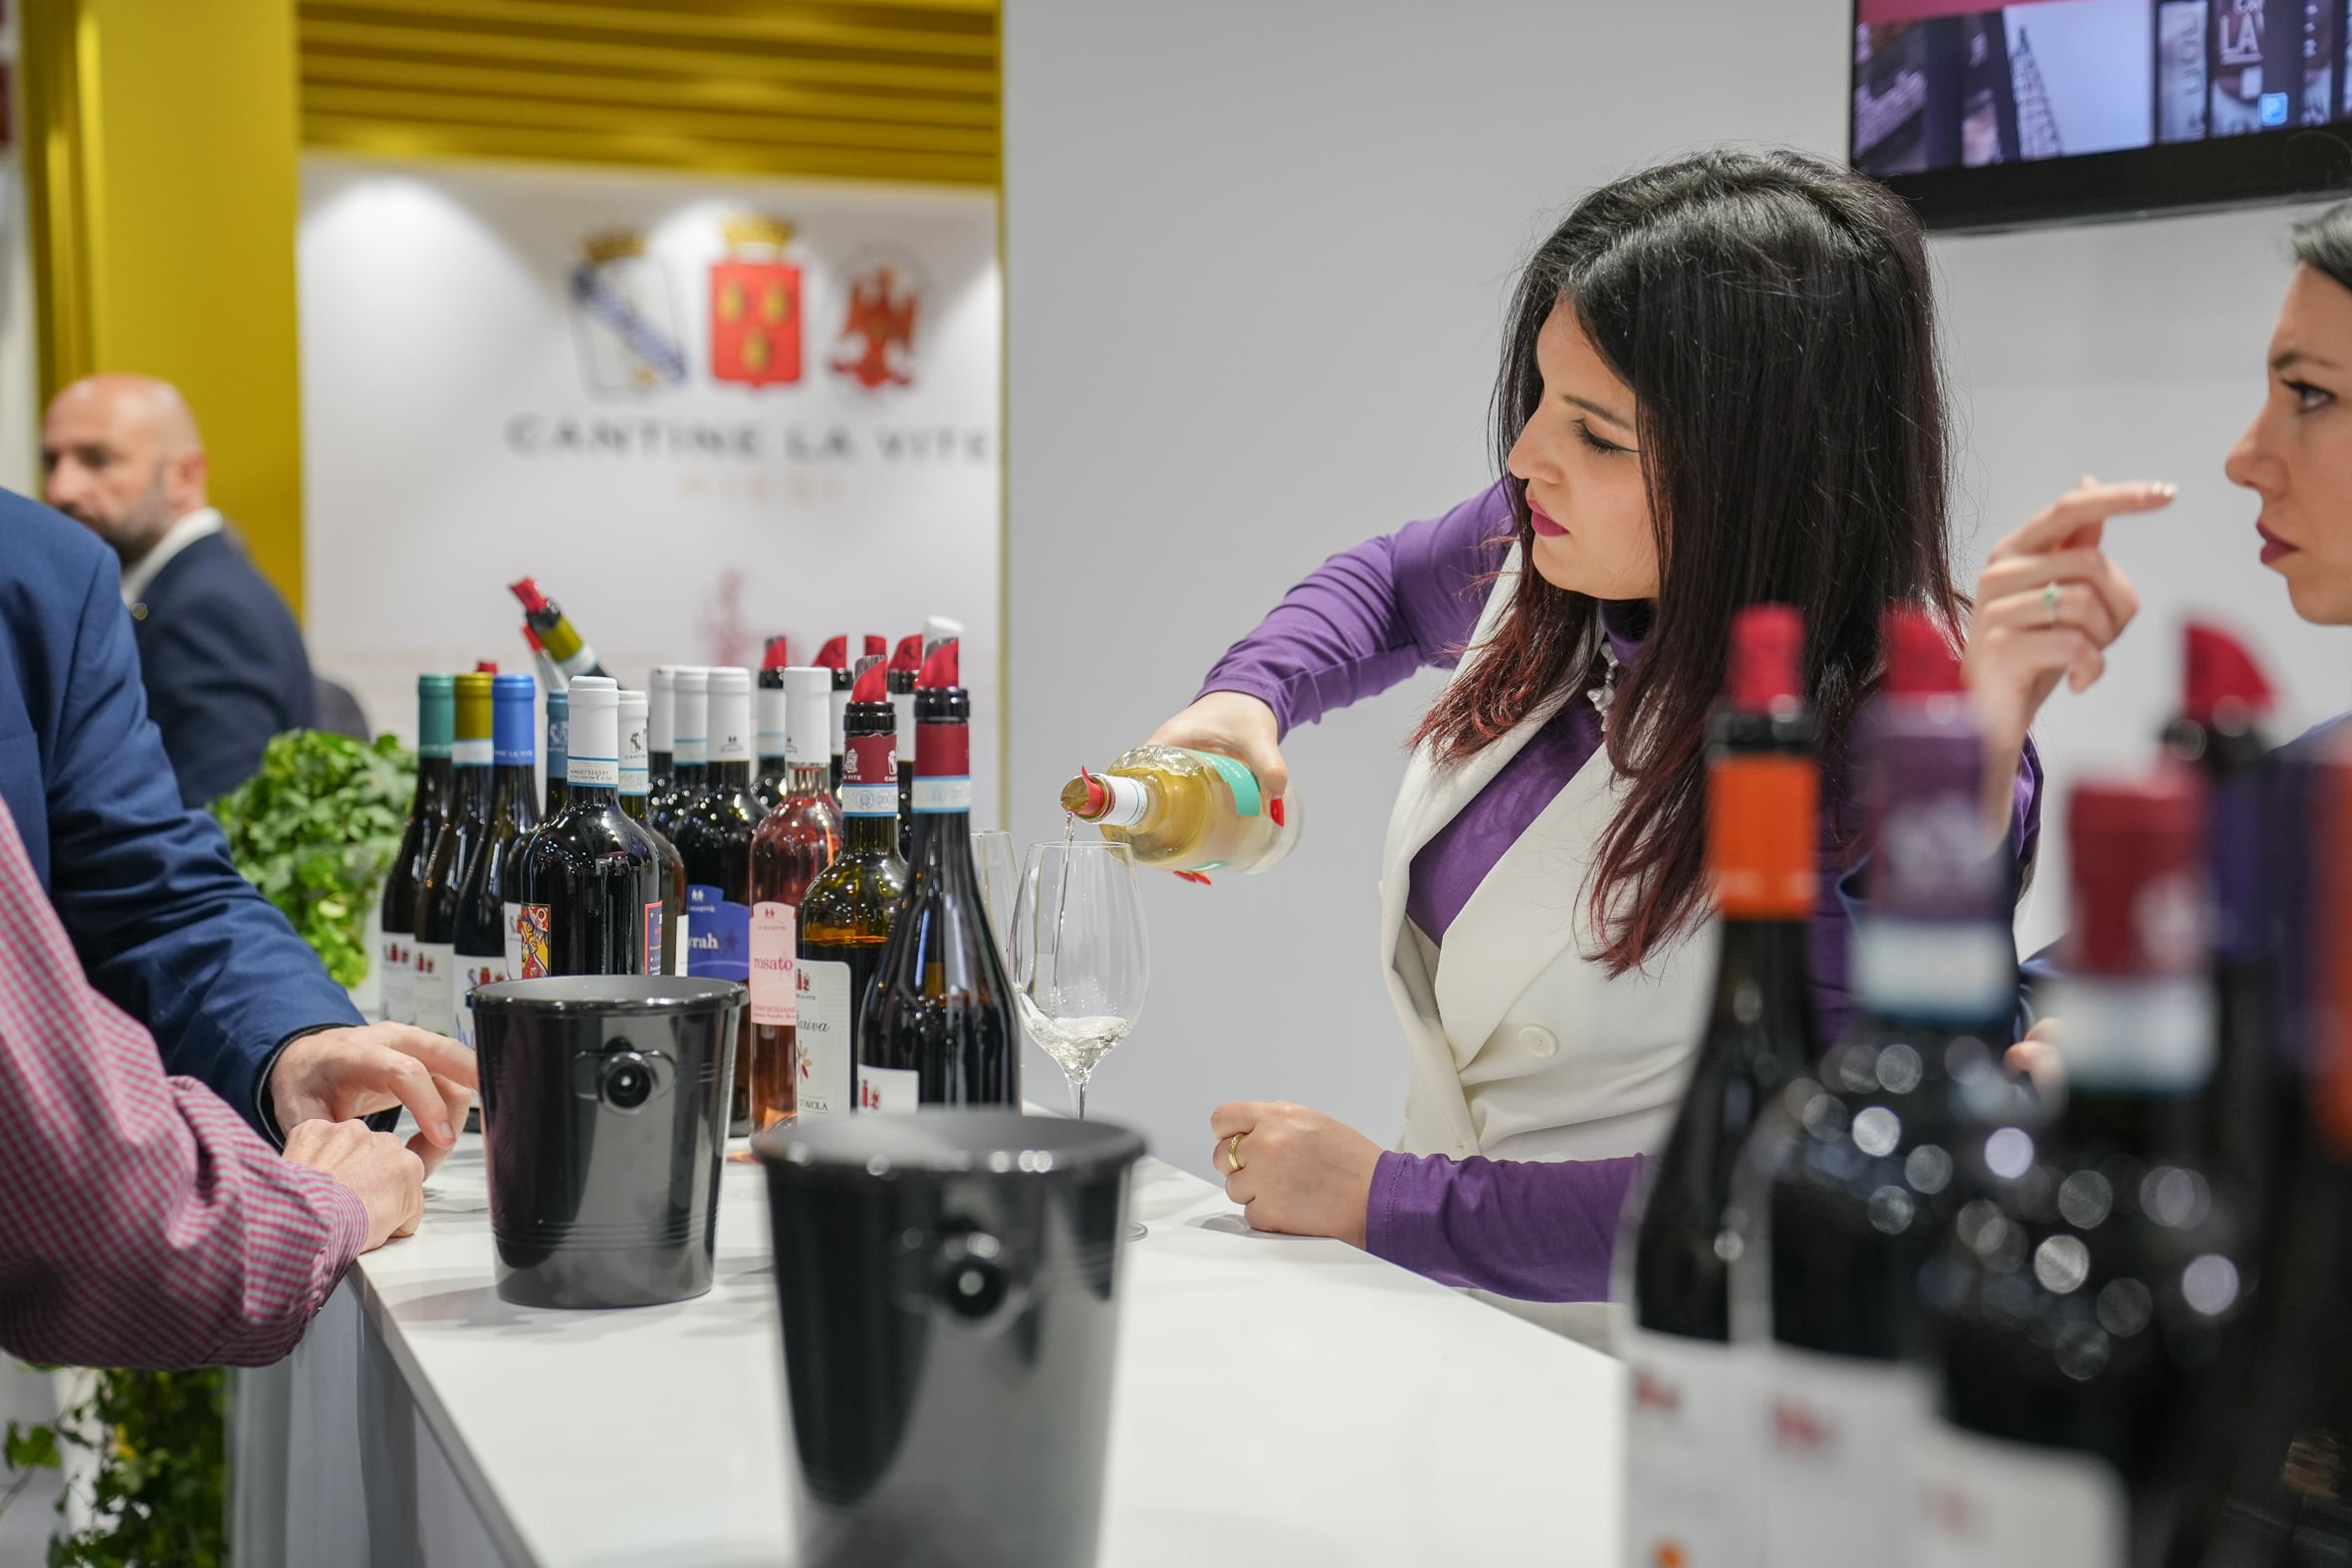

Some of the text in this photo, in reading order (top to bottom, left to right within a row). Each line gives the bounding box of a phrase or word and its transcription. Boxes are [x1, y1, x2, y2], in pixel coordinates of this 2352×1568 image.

[504, 412, 993, 462] CANTINE LA VITE
[753, 957, 794, 972] rosato
